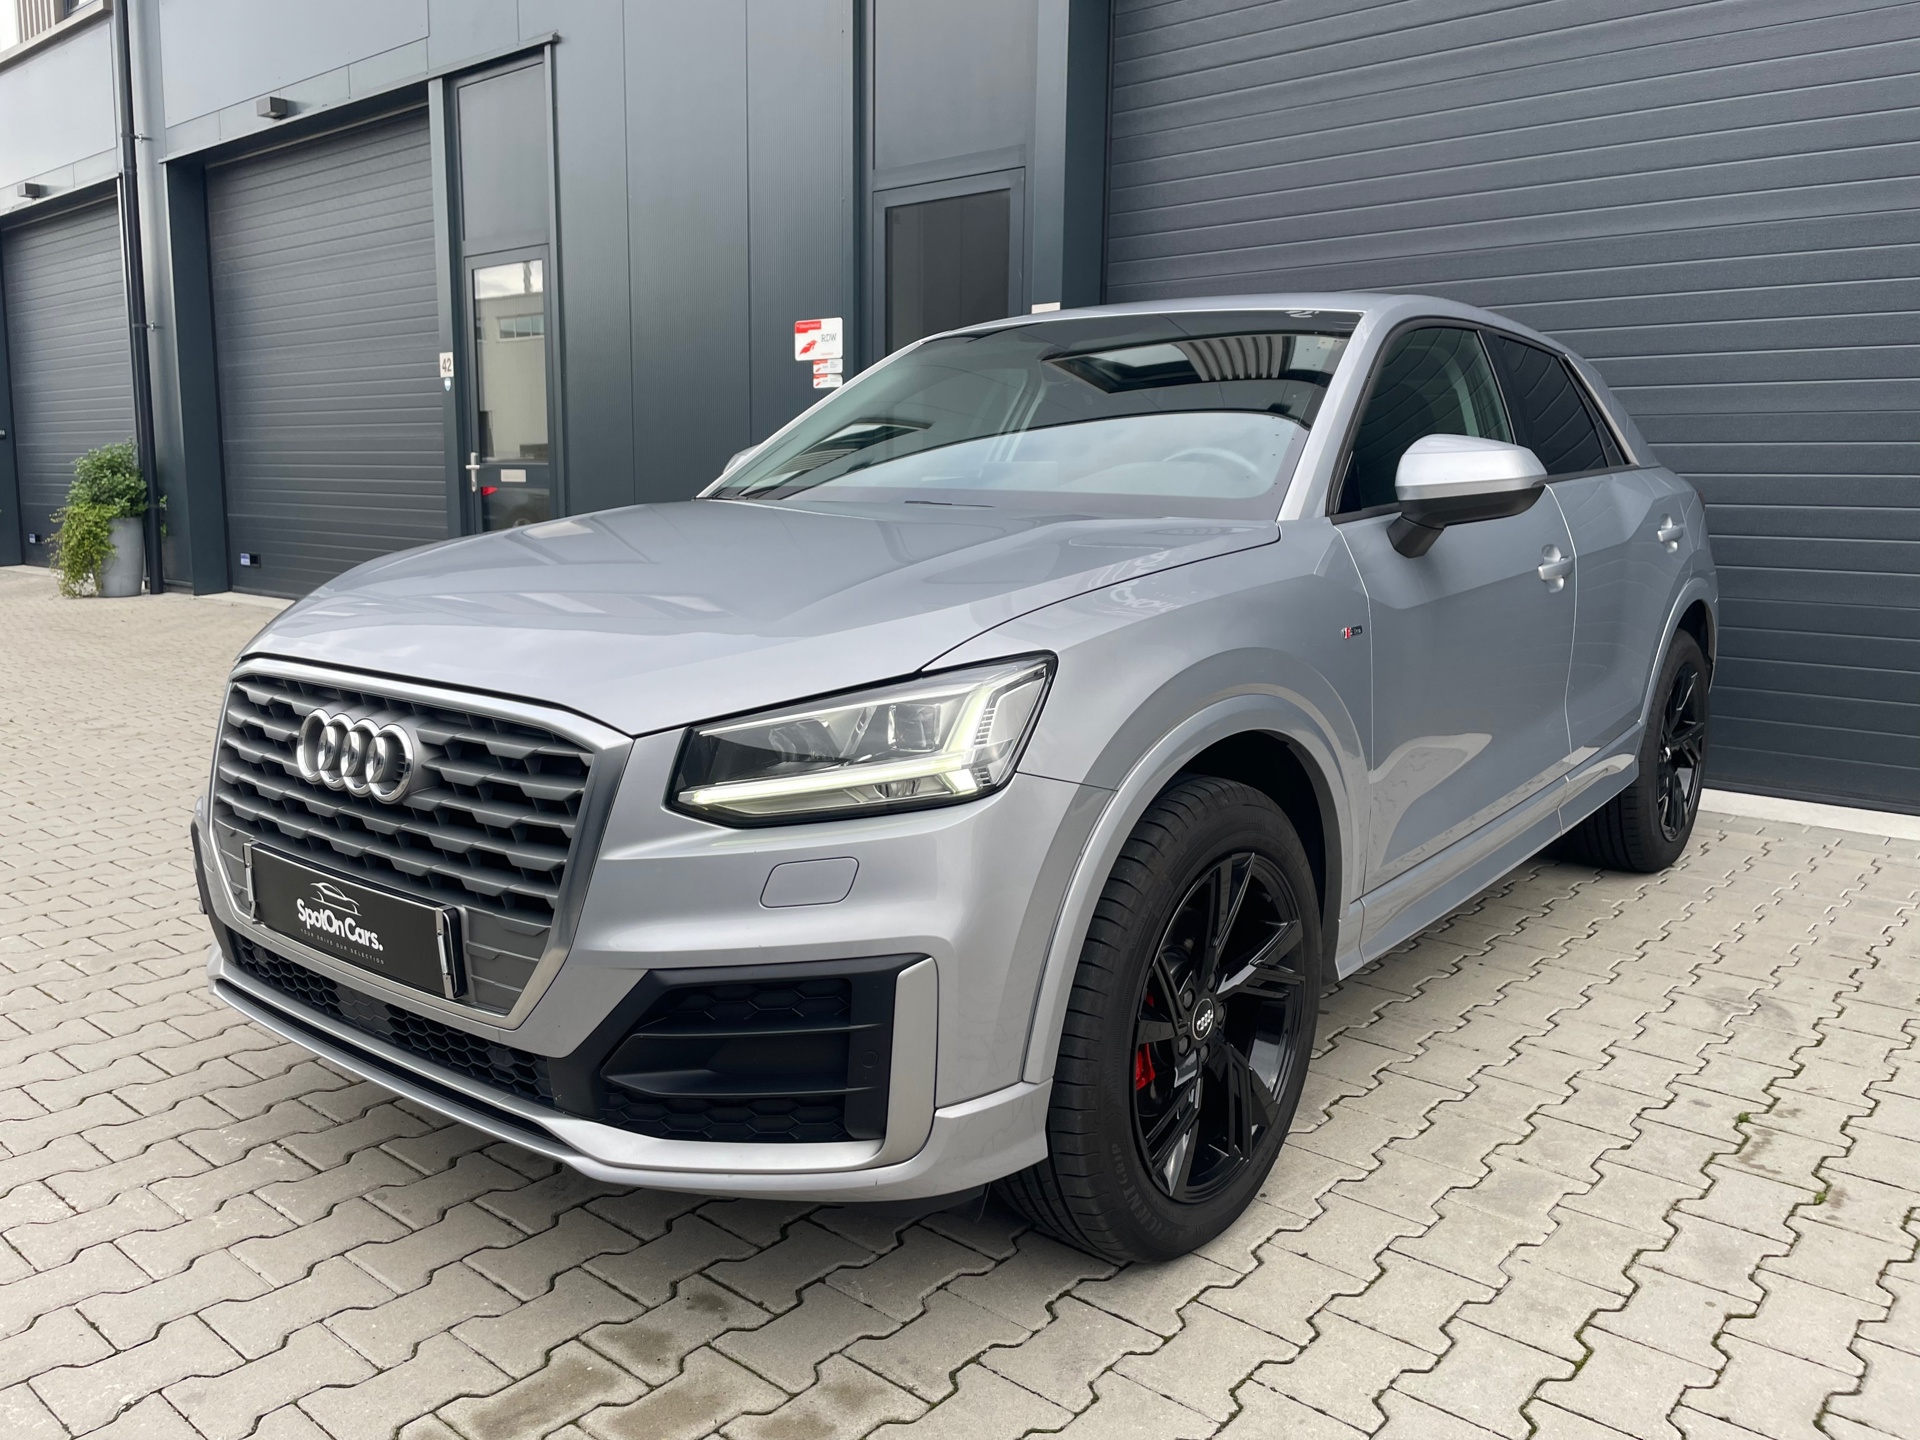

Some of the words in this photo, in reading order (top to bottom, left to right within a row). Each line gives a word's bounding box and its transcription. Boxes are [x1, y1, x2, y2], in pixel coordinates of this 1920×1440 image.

[821, 333, 837, 342] RDW
[442, 358, 452, 372] 42
[300, 928, 315, 938] YOUR
[316, 935, 333, 946] DRIVE
[336, 942, 348, 951] OUR
[350, 948, 385, 965] SELECTION
